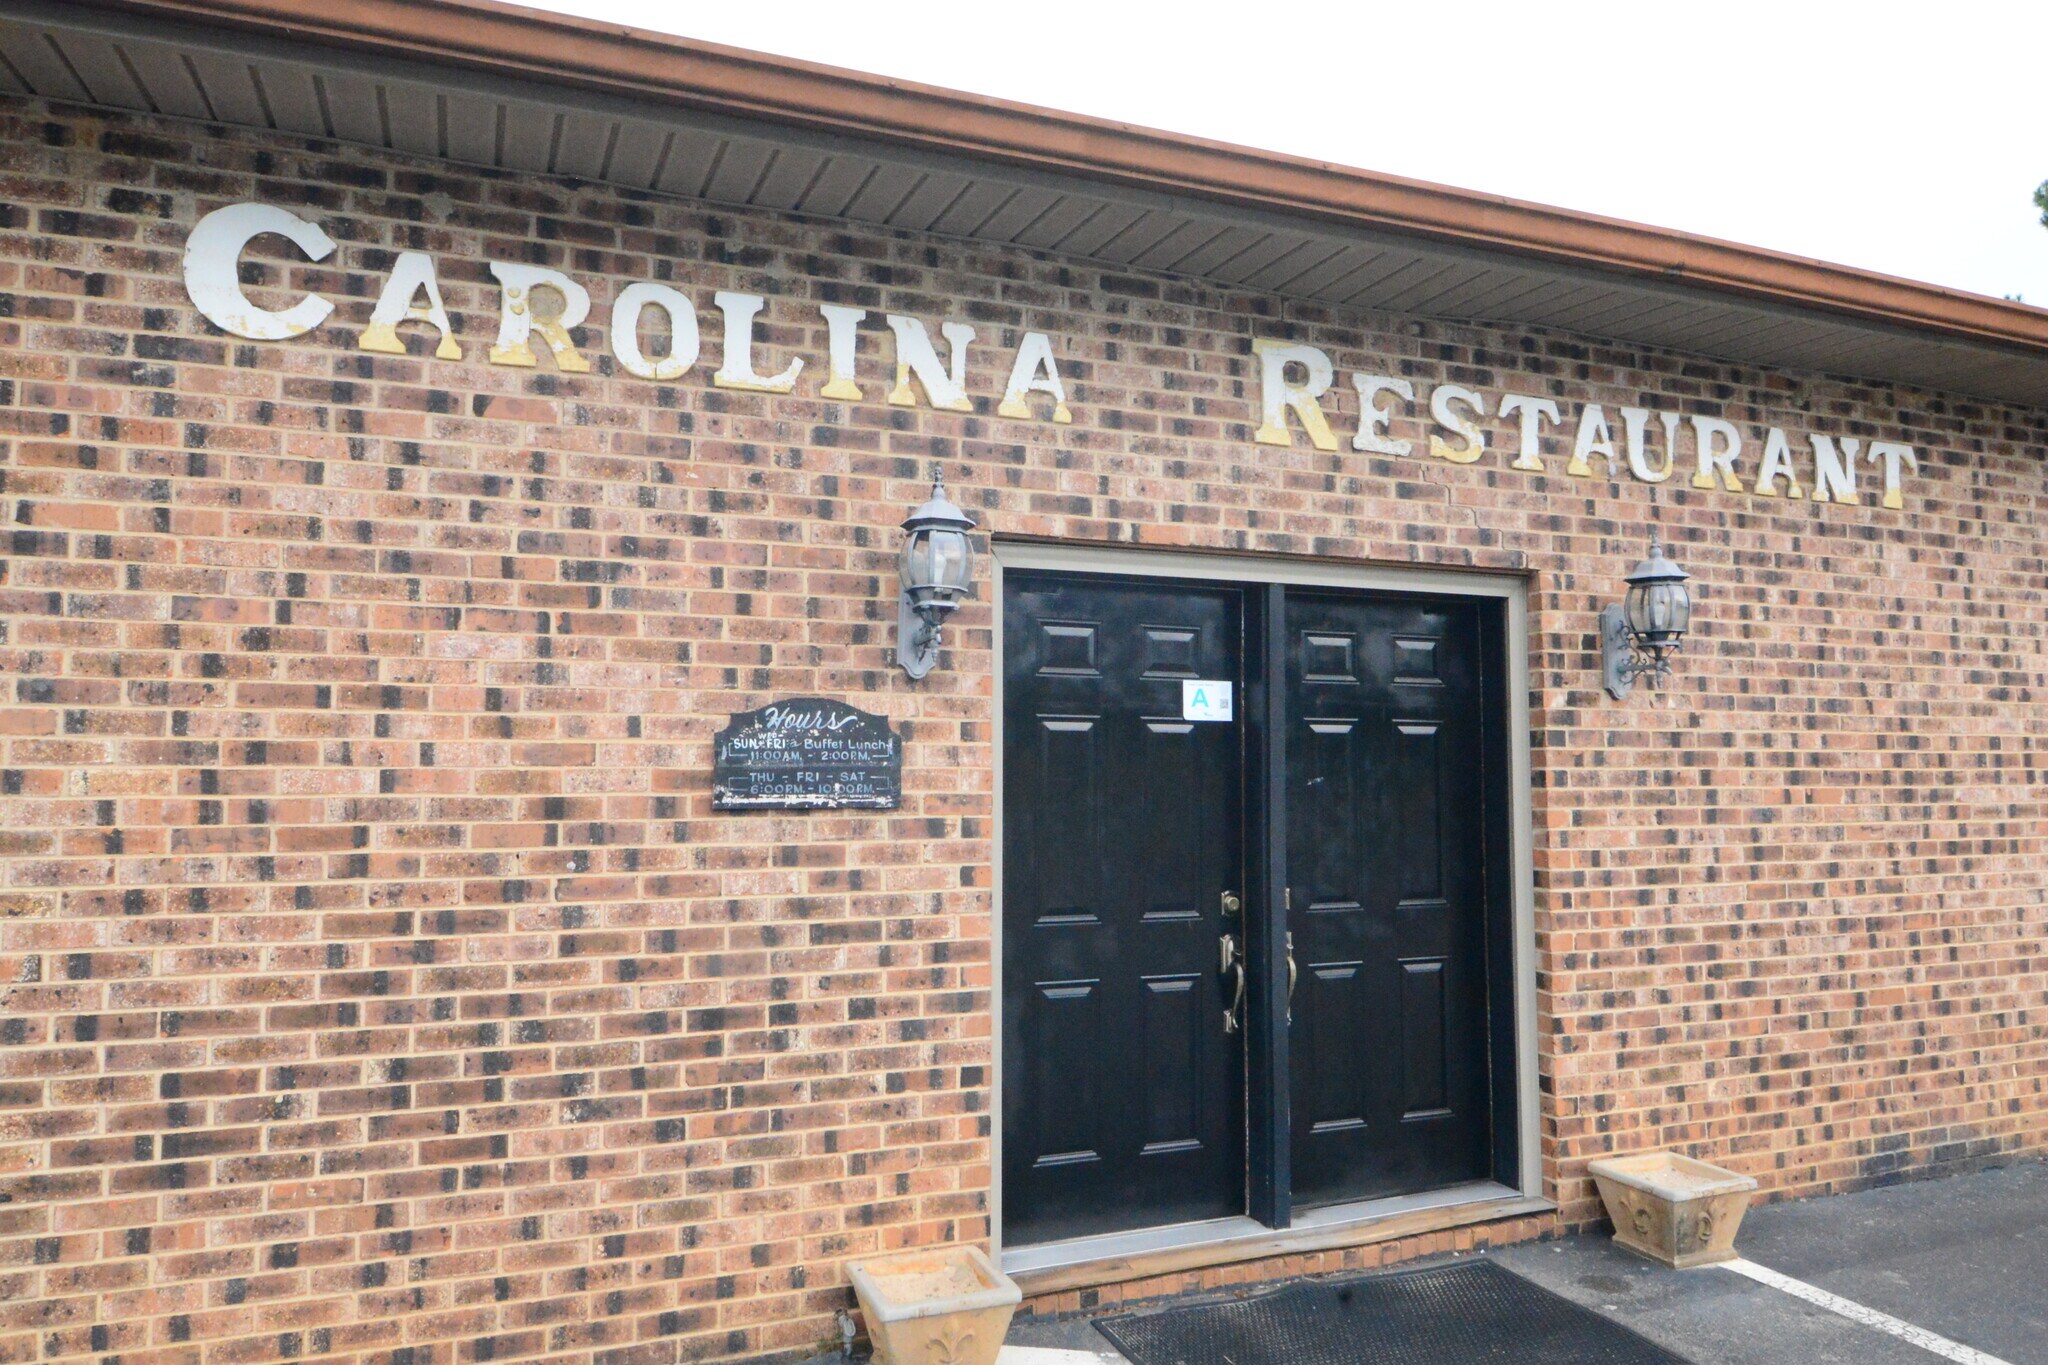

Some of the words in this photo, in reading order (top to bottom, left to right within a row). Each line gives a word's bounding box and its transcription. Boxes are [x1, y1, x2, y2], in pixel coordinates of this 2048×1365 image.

[181, 202, 1073, 424] CAROLINA
[1252, 338, 1916, 509] RESTAURANT
[1191, 688, 1209, 708] A
[765, 707, 858, 730] Hours
[804, 738, 844, 750] Buffet
[848, 738, 886, 750] Lunch
[749, 772, 775, 782] THU
[796, 771, 820, 782] FRI
[840, 771, 866, 782] SAT
